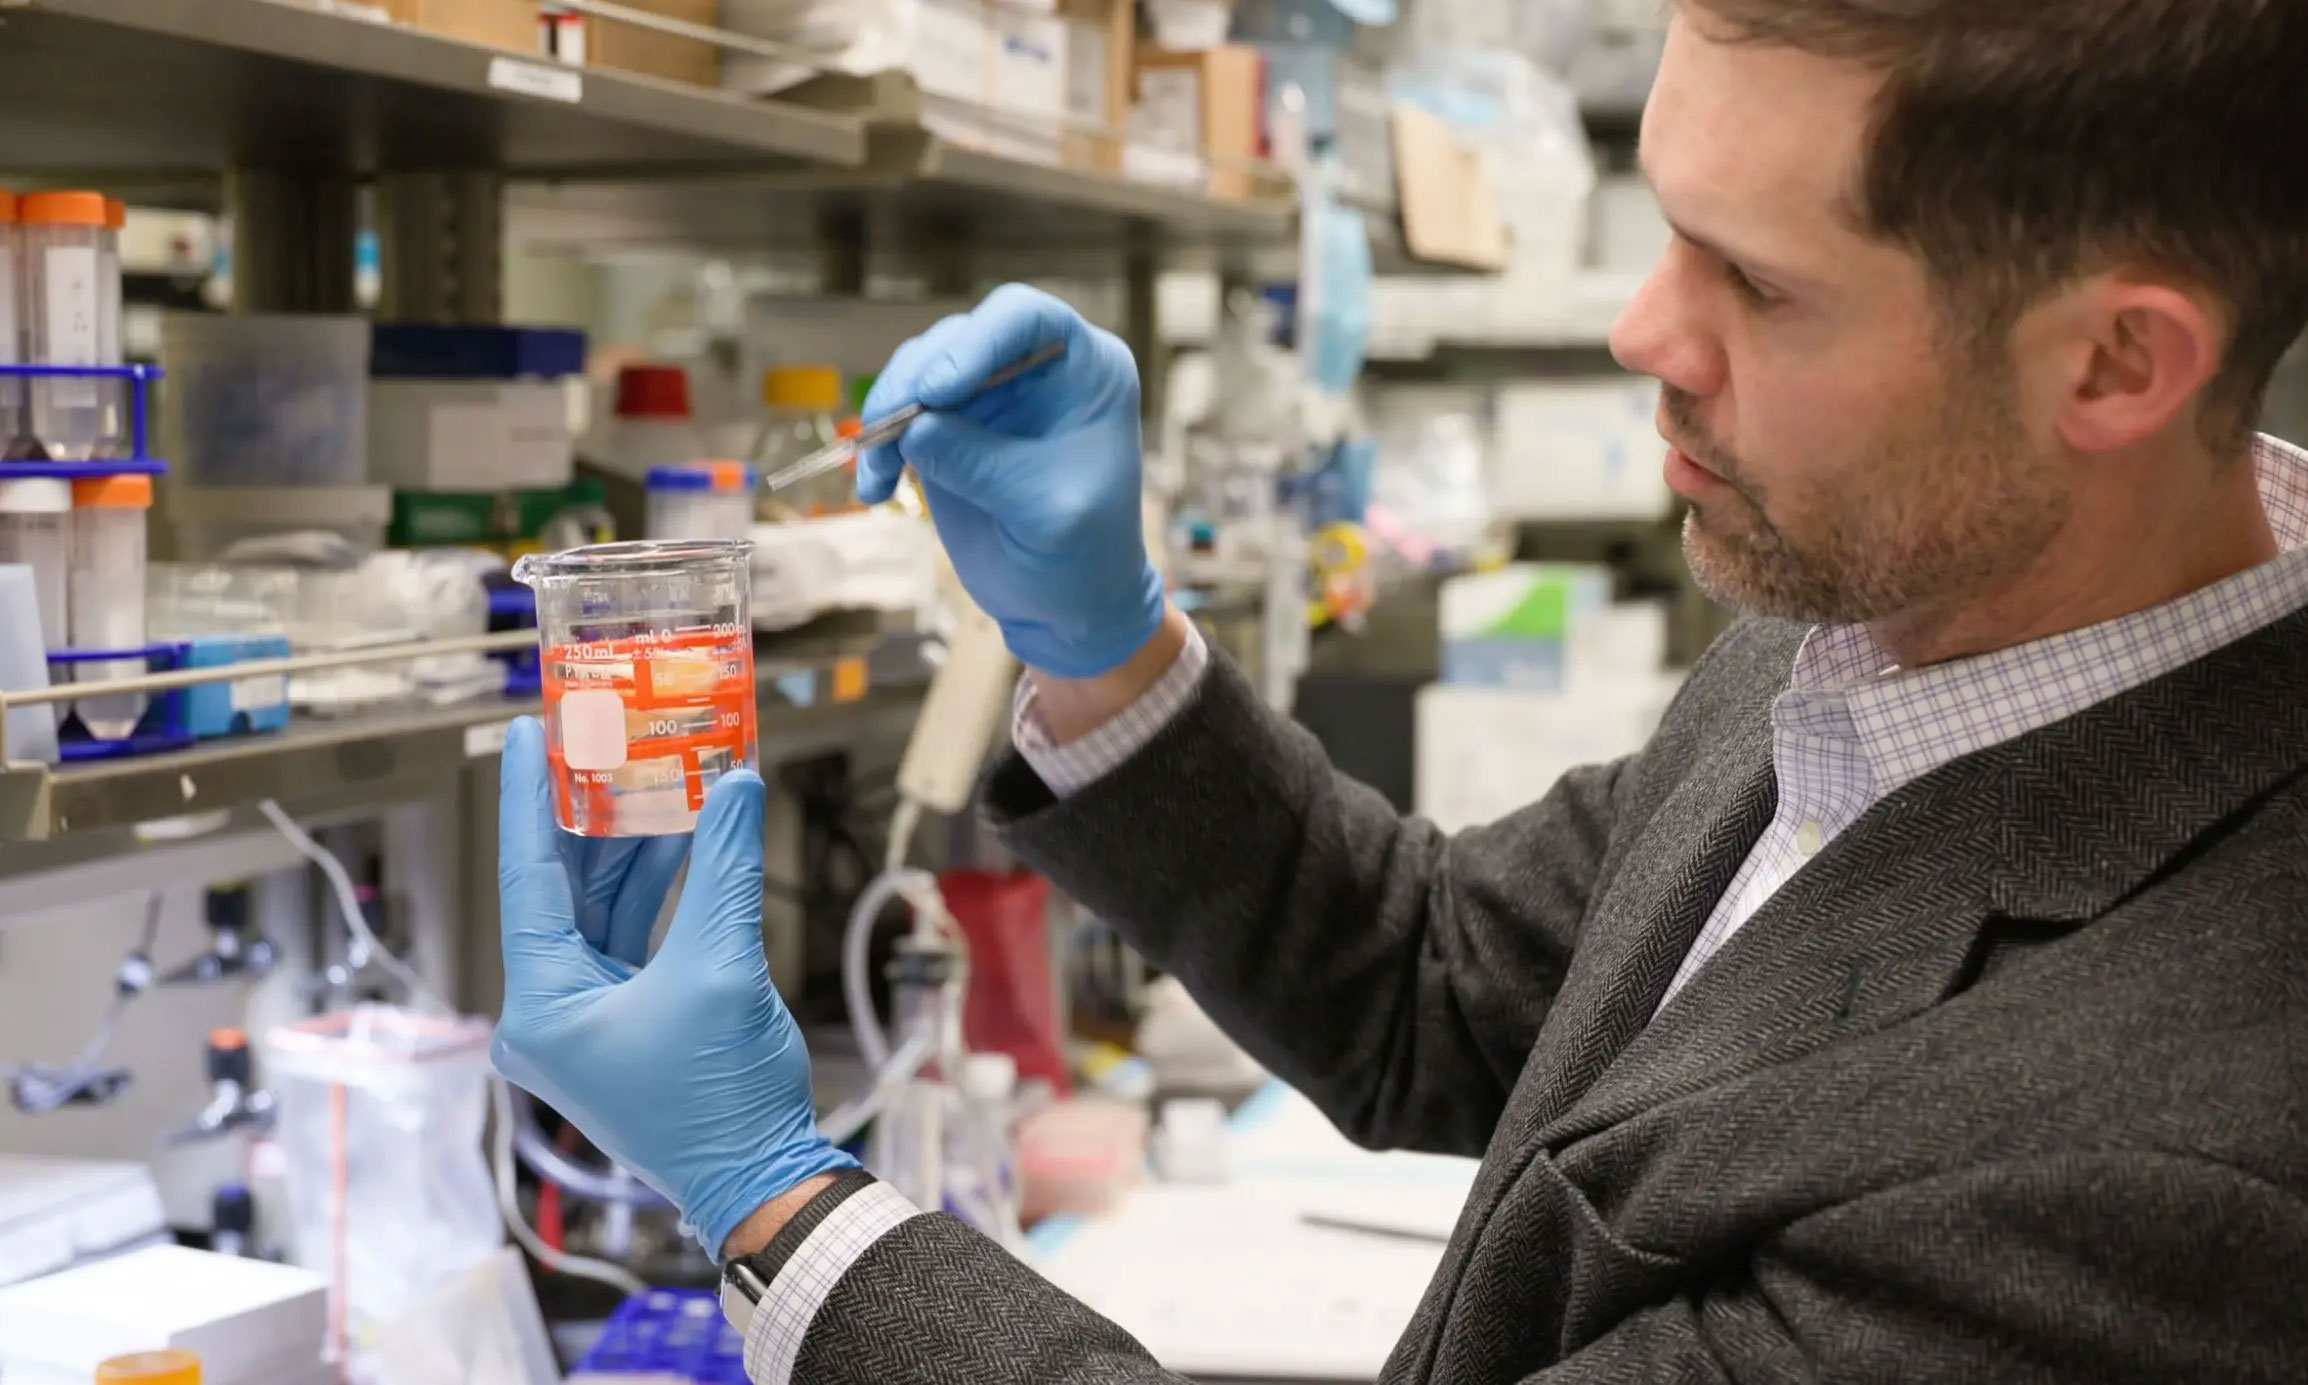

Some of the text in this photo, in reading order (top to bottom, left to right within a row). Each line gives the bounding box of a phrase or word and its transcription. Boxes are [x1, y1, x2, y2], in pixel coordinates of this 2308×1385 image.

[712, 622, 735, 639] 200
[648, 711, 740, 736] 100 100
[730, 759, 744, 771] 50
[574, 772, 589, 784] No.
